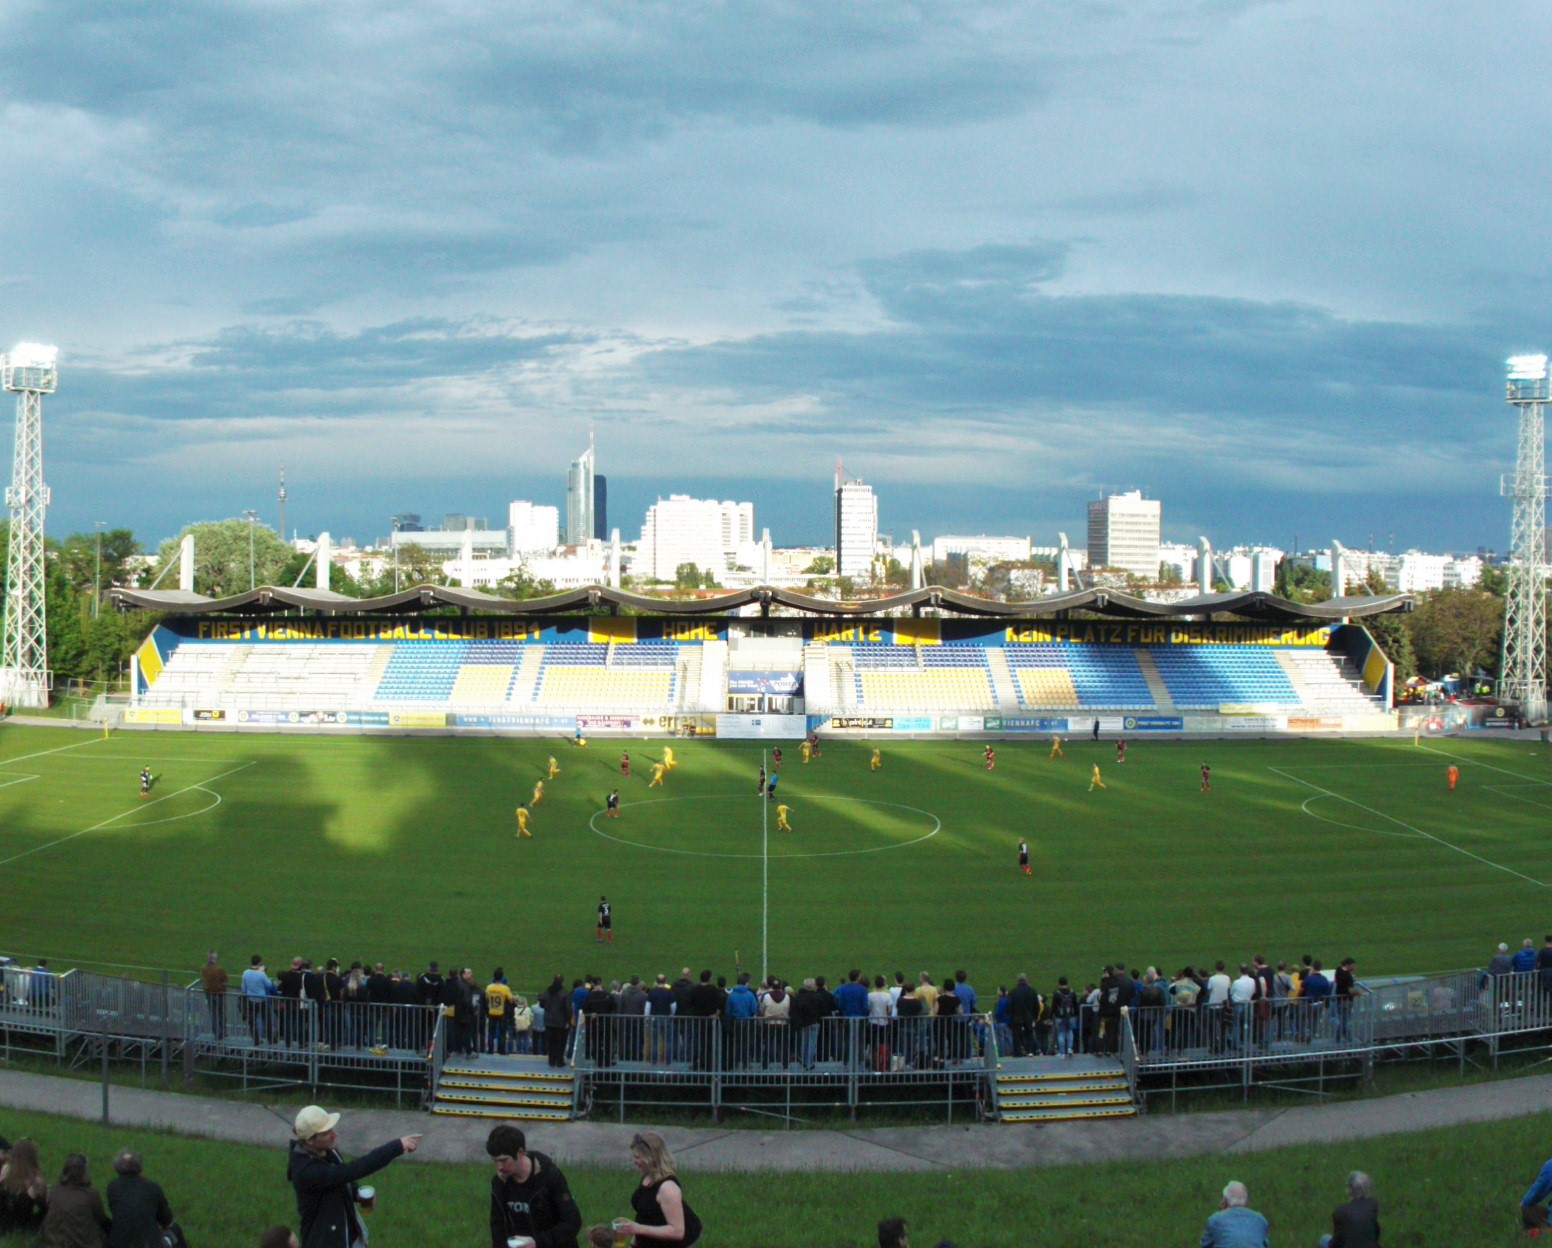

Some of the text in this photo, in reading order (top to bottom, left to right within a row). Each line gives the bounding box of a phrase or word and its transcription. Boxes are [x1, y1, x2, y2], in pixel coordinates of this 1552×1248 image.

[198, 621, 540, 640] FIRST VIENNA FOOTBALL CLUB 1894
[662, 622, 883, 642] HOHE WARTE
[1005, 625, 1052, 643] KEIN
[1056, 624, 1123, 643] PLATZ
[1170, 625, 1332, 645] DISKRIMINIERUNG
[490, 995, 502, 1008] 19
